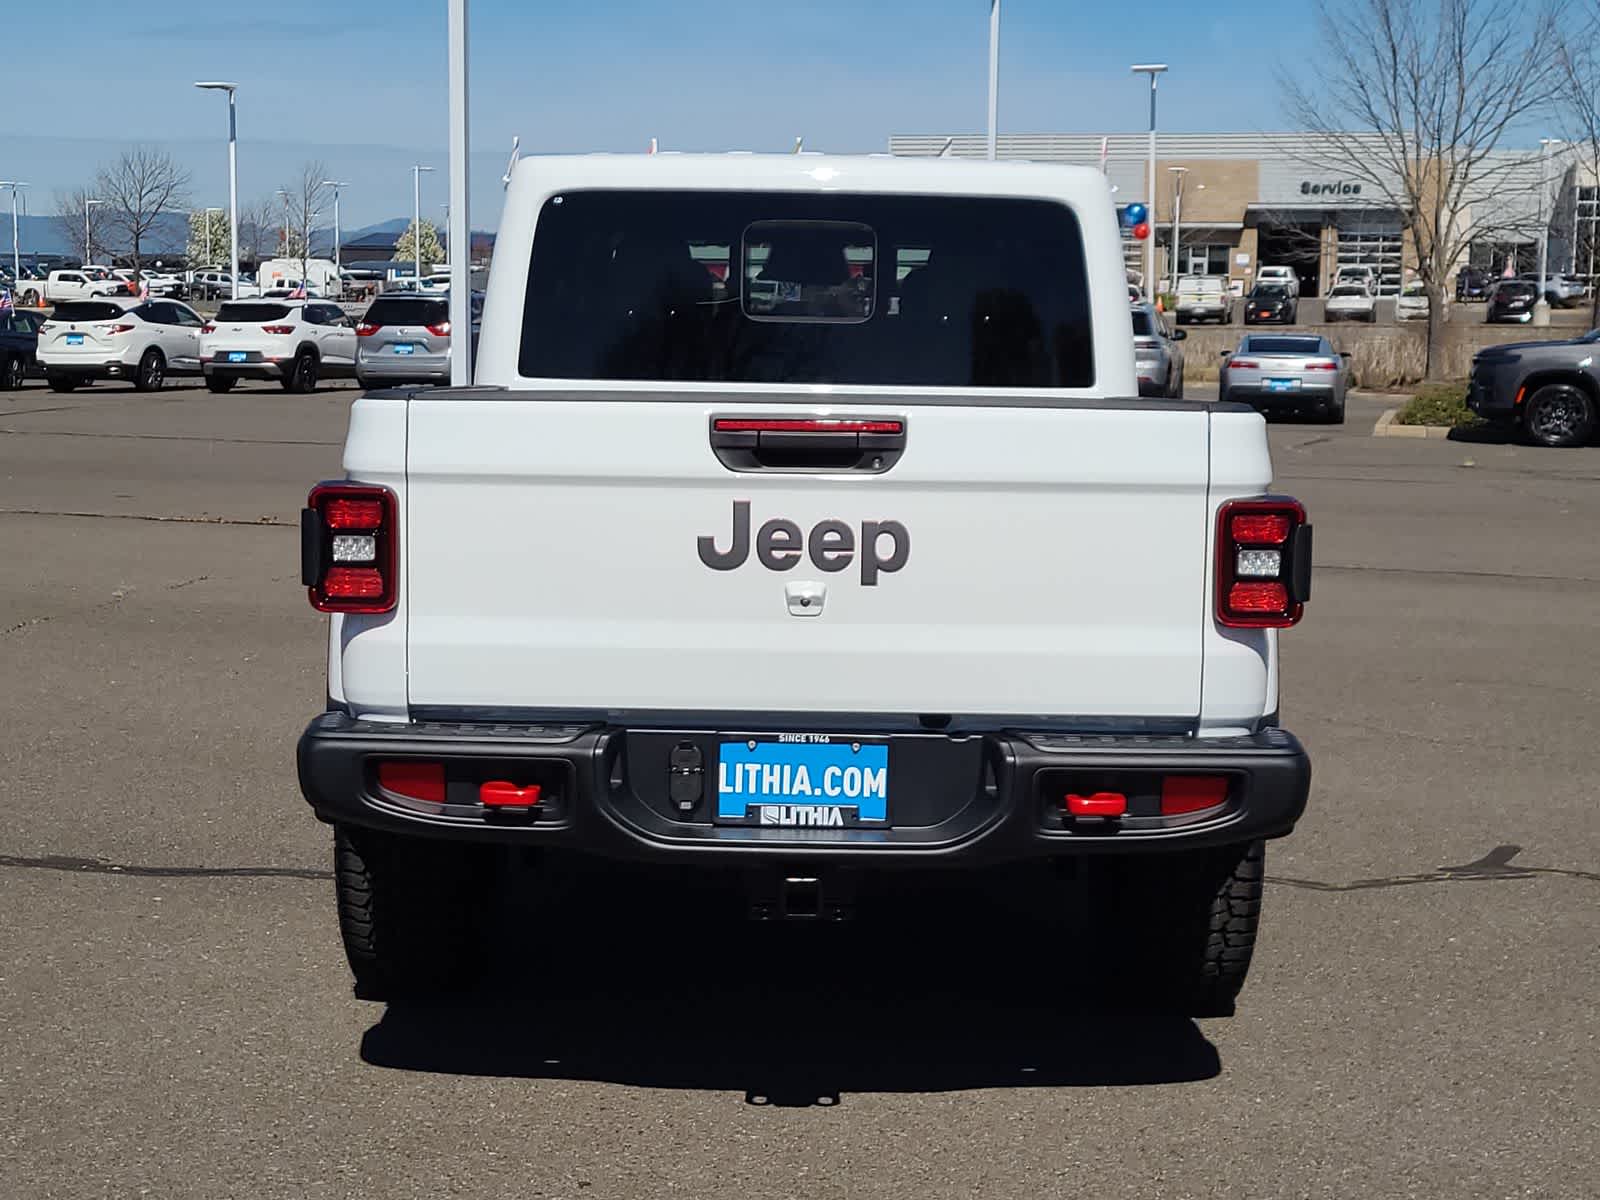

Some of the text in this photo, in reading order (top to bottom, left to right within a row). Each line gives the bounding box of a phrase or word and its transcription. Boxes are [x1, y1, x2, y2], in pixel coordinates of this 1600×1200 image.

[1301, 180, 1361, 195] Service
[697, 500, 910, 586] Jeep
[778, 734, 830, 744] SINCE 1946
[718, 762, 887, 798] LITHIA.COM
[779, 806, 844, 826] LITHIA
